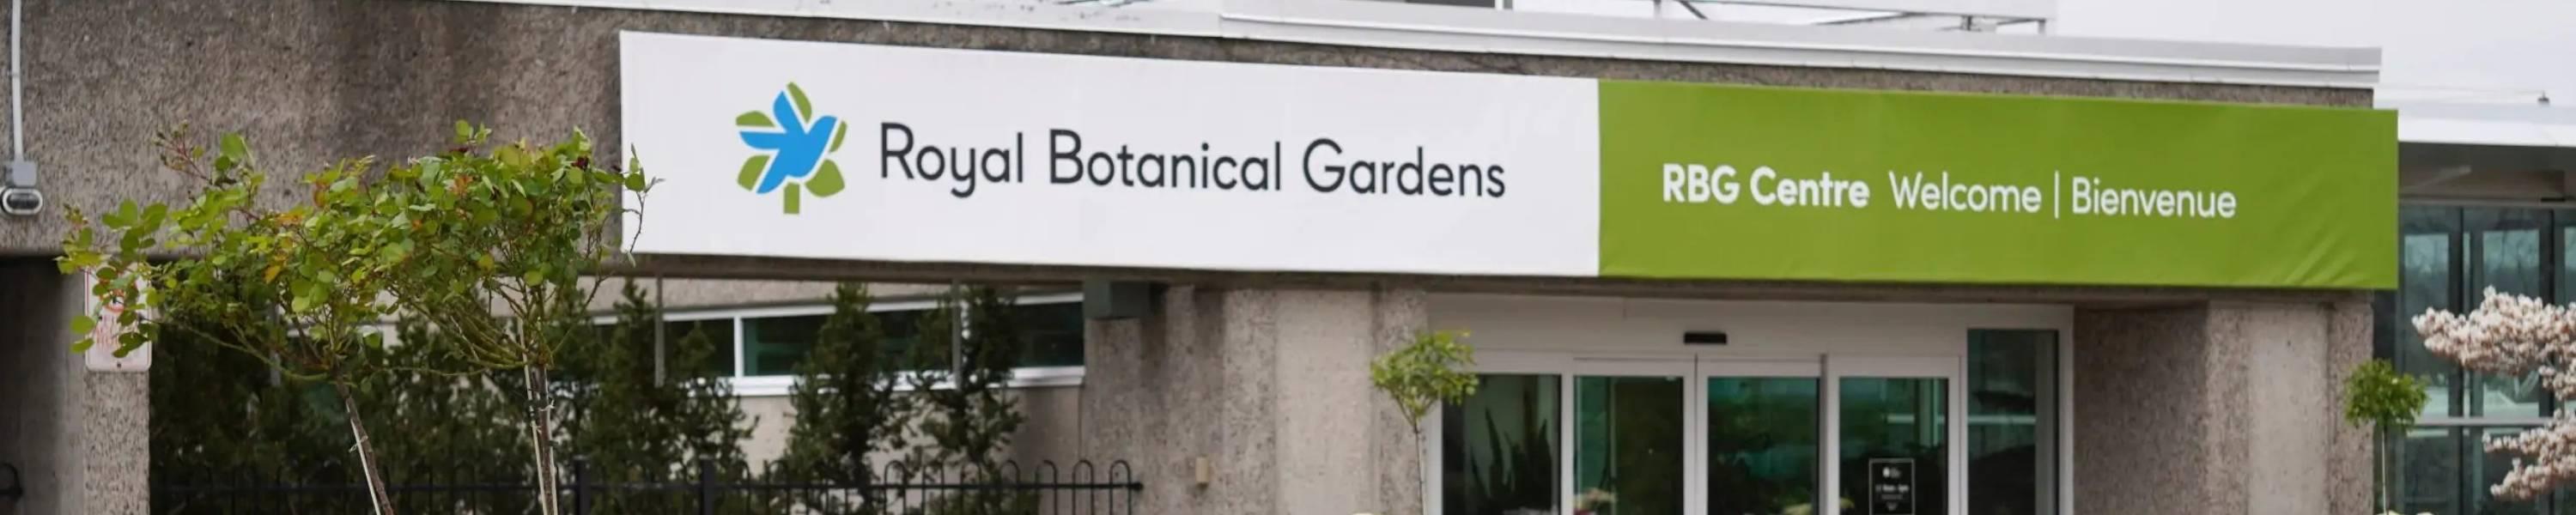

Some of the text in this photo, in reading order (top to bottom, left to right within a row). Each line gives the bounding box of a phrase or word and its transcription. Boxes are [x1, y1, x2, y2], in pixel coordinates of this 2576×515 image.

[881, 122, 1506, 199] Royal Botanical Gardens
[1662, 163, 2237, 218] RBG Centre Welcome Bienvenue
